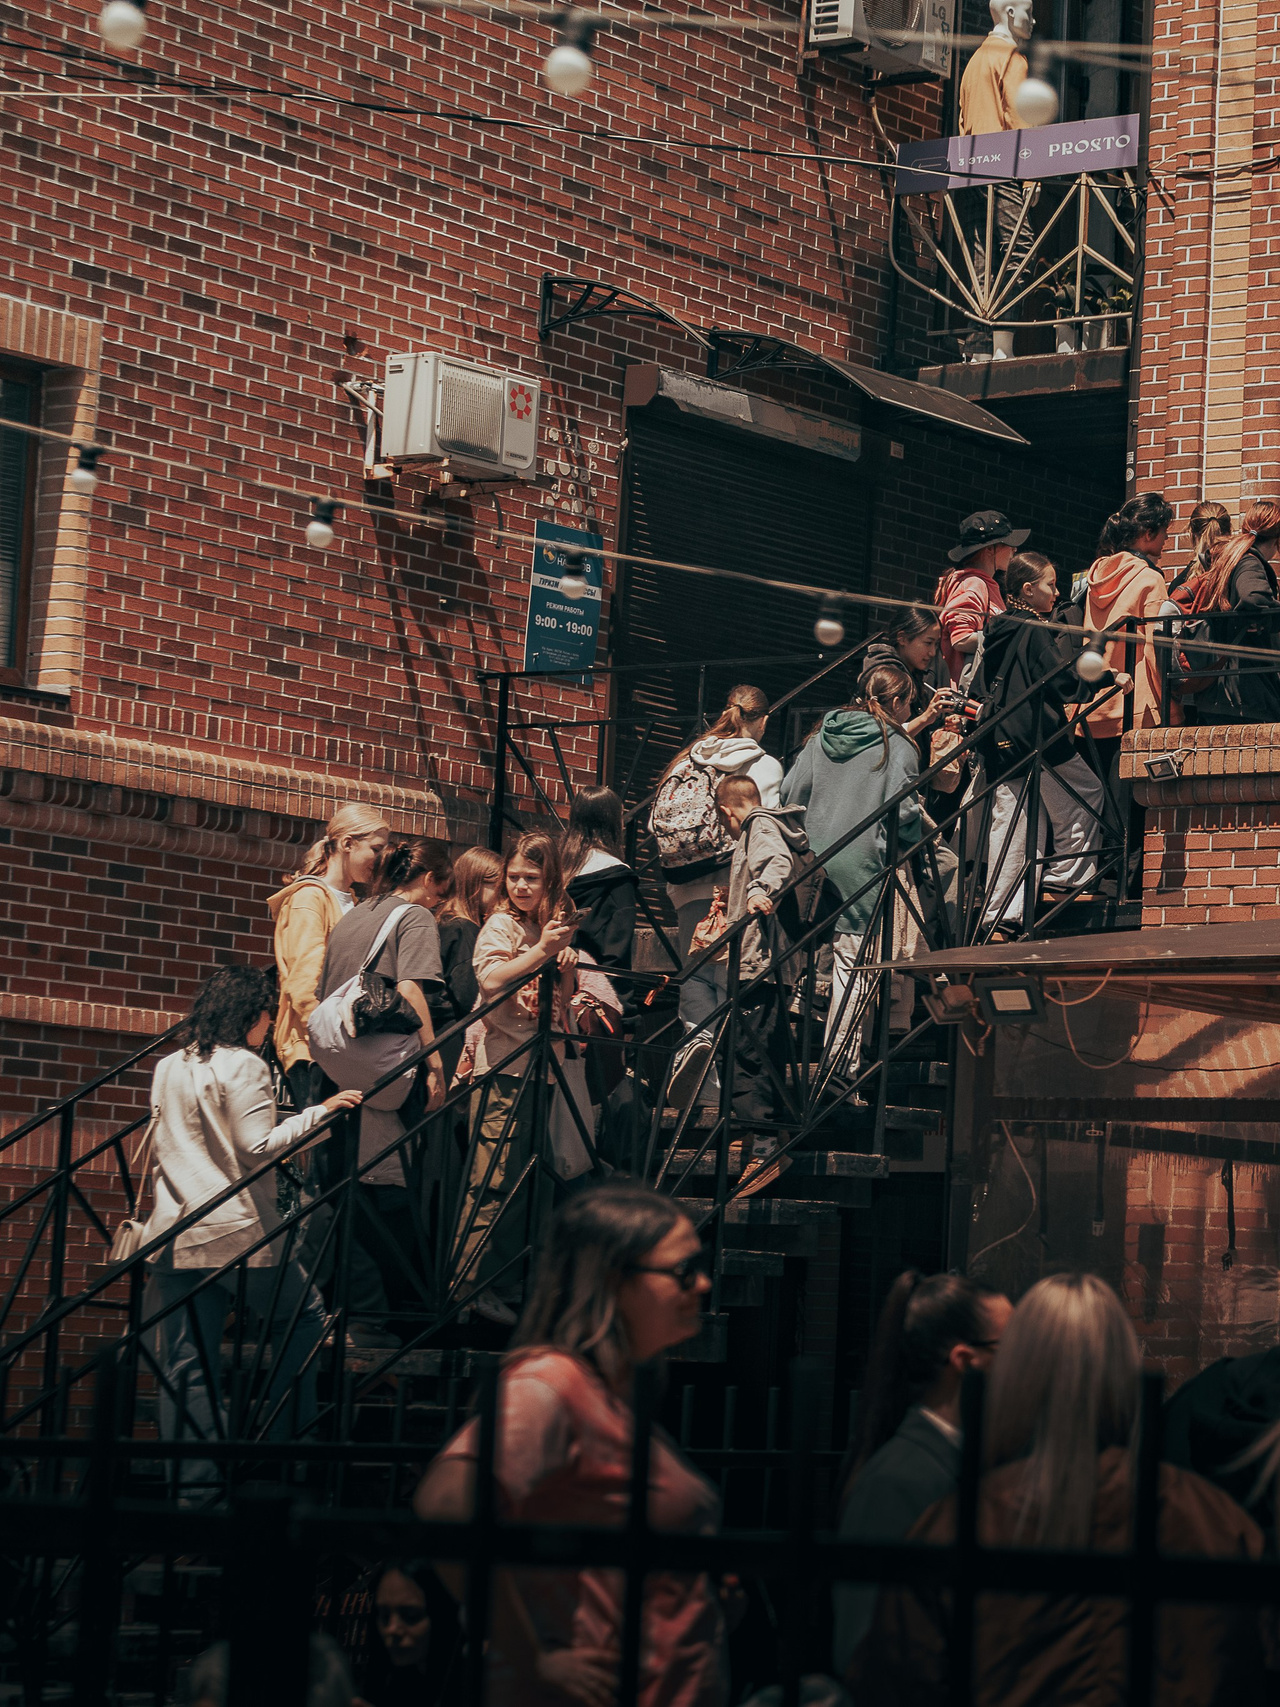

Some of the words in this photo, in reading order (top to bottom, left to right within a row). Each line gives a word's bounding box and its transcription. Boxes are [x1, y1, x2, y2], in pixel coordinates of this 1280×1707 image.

[932, 2, 946, 21] LG
[1048, 134, 1131, 157] PROSTO
[969, 153, 1001, 165] ЭТАЖ
[538, 577, 560, 589] ТУРИЗМ
[545, 601, 564, 612] РЕЖИМ
[564, 605, 585, 616] РАБОТЫ
[535, 614, 557, 629] 9:00
[566, 621, 593, 637] 19:00
